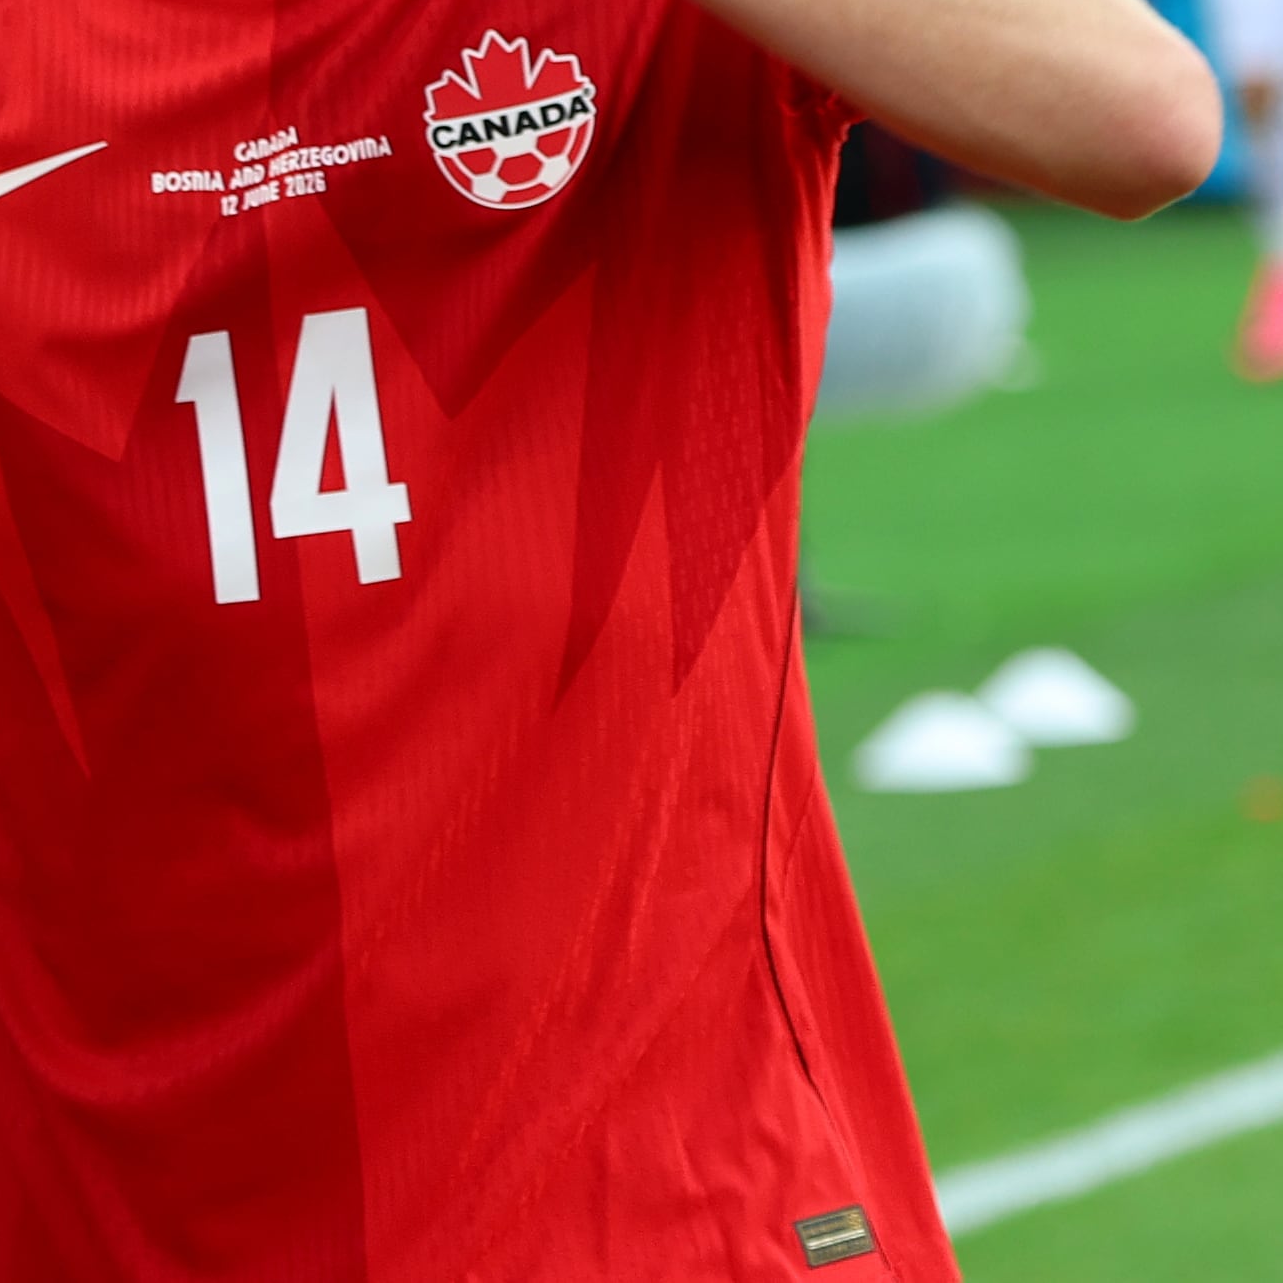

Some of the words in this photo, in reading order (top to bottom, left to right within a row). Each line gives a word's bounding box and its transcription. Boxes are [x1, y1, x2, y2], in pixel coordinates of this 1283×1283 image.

[234, 126, 299, 162] CANADA
[432, 95, 589, 149] CANADA
[151, 171, 225, 194] BOSNIA
[229, 164, 265, 190] AND
[268, 135, 393, 178] HERZEGOVINA
[221, 194, 238, 216] 12
[242, 181, 280, 210] JUNE
[285, 171, 327, 197] 2026
[175, 307, 412, 605] 14
